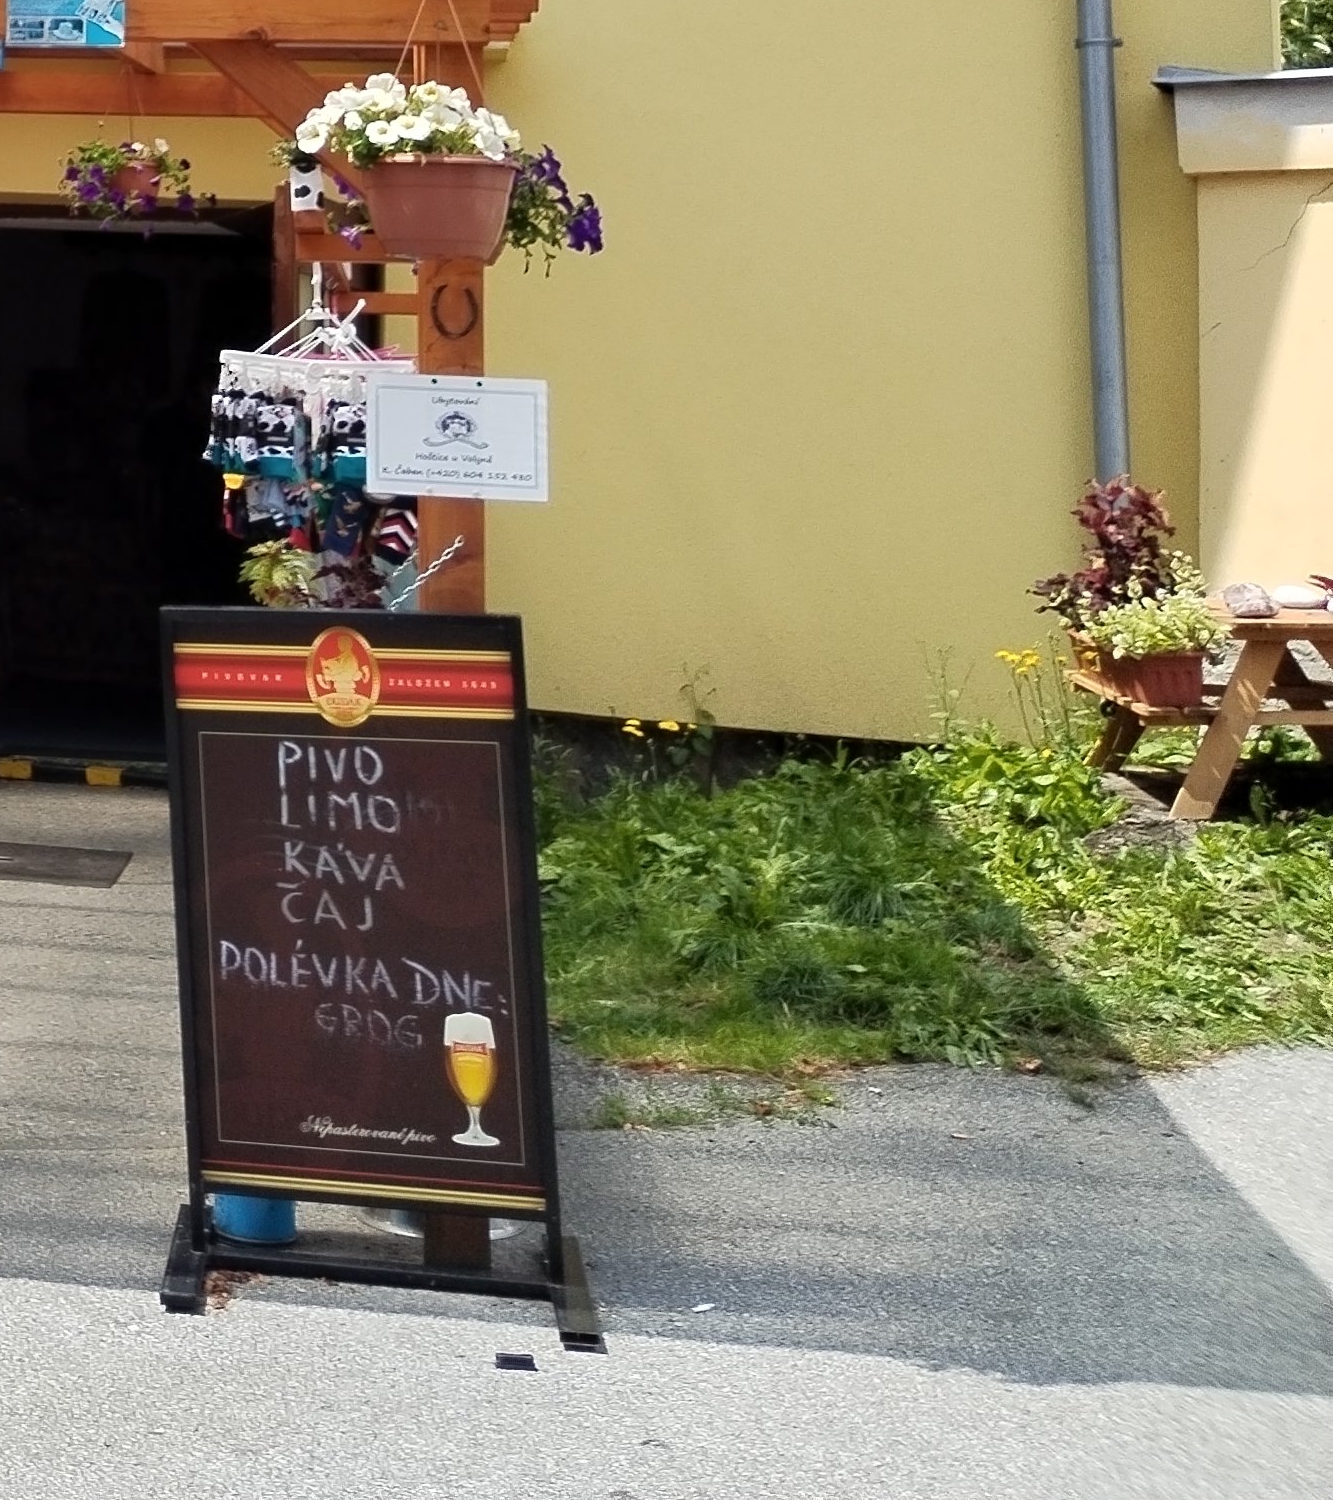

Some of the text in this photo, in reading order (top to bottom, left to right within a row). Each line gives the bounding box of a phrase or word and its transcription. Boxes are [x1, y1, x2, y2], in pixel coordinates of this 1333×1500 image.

[278, 741, 383, 788] PIVO
[281, 792, 400, 833] LIMO
[276, 882, 374, 931] ČAJ
[220, 939, 398, 999] POLÉVKA
[315, 1003, 423, 1048] GROG
